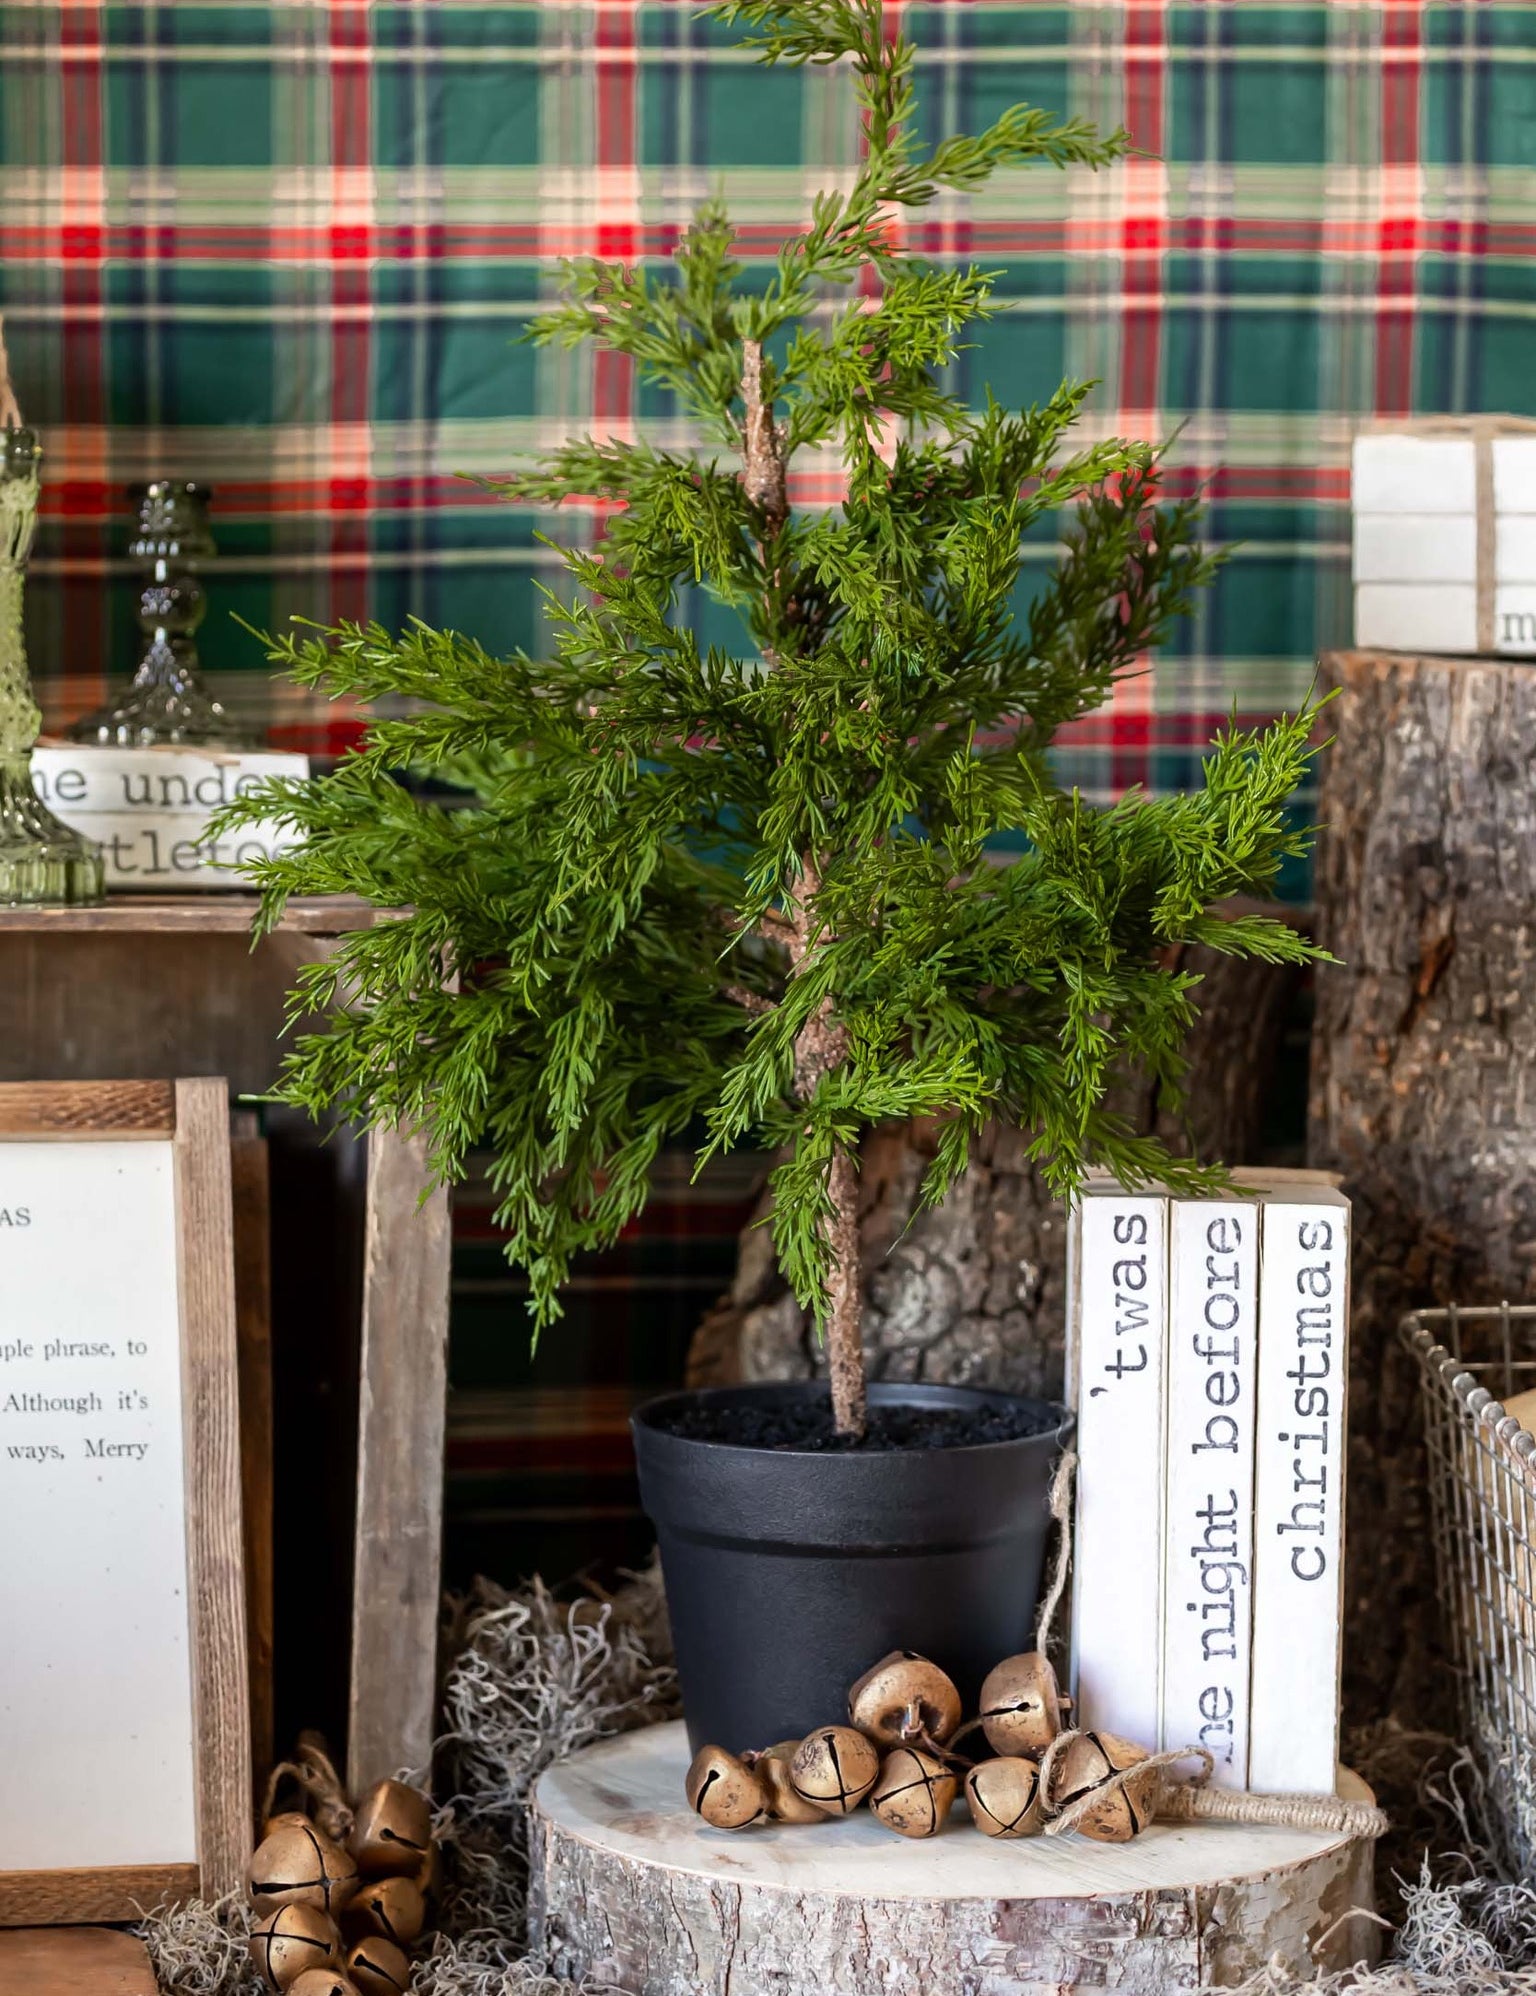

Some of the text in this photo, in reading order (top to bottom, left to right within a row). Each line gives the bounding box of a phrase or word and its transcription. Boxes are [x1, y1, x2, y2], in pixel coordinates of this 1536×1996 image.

[120, 765, 302, 808] unde
[0, 1338, 148, 1362] ple phrase, to
[1090, 1213, 1149, 1398] 'twas
[1191, 1217, 1242, 1455] before
[3, 1389, 148, 1414] Although it's
[7, 1438, 148, 1464] ways, Merry
[1276, 1219, 1333, 1582] christmas
[1186, 1488, 1249, 1661] night
